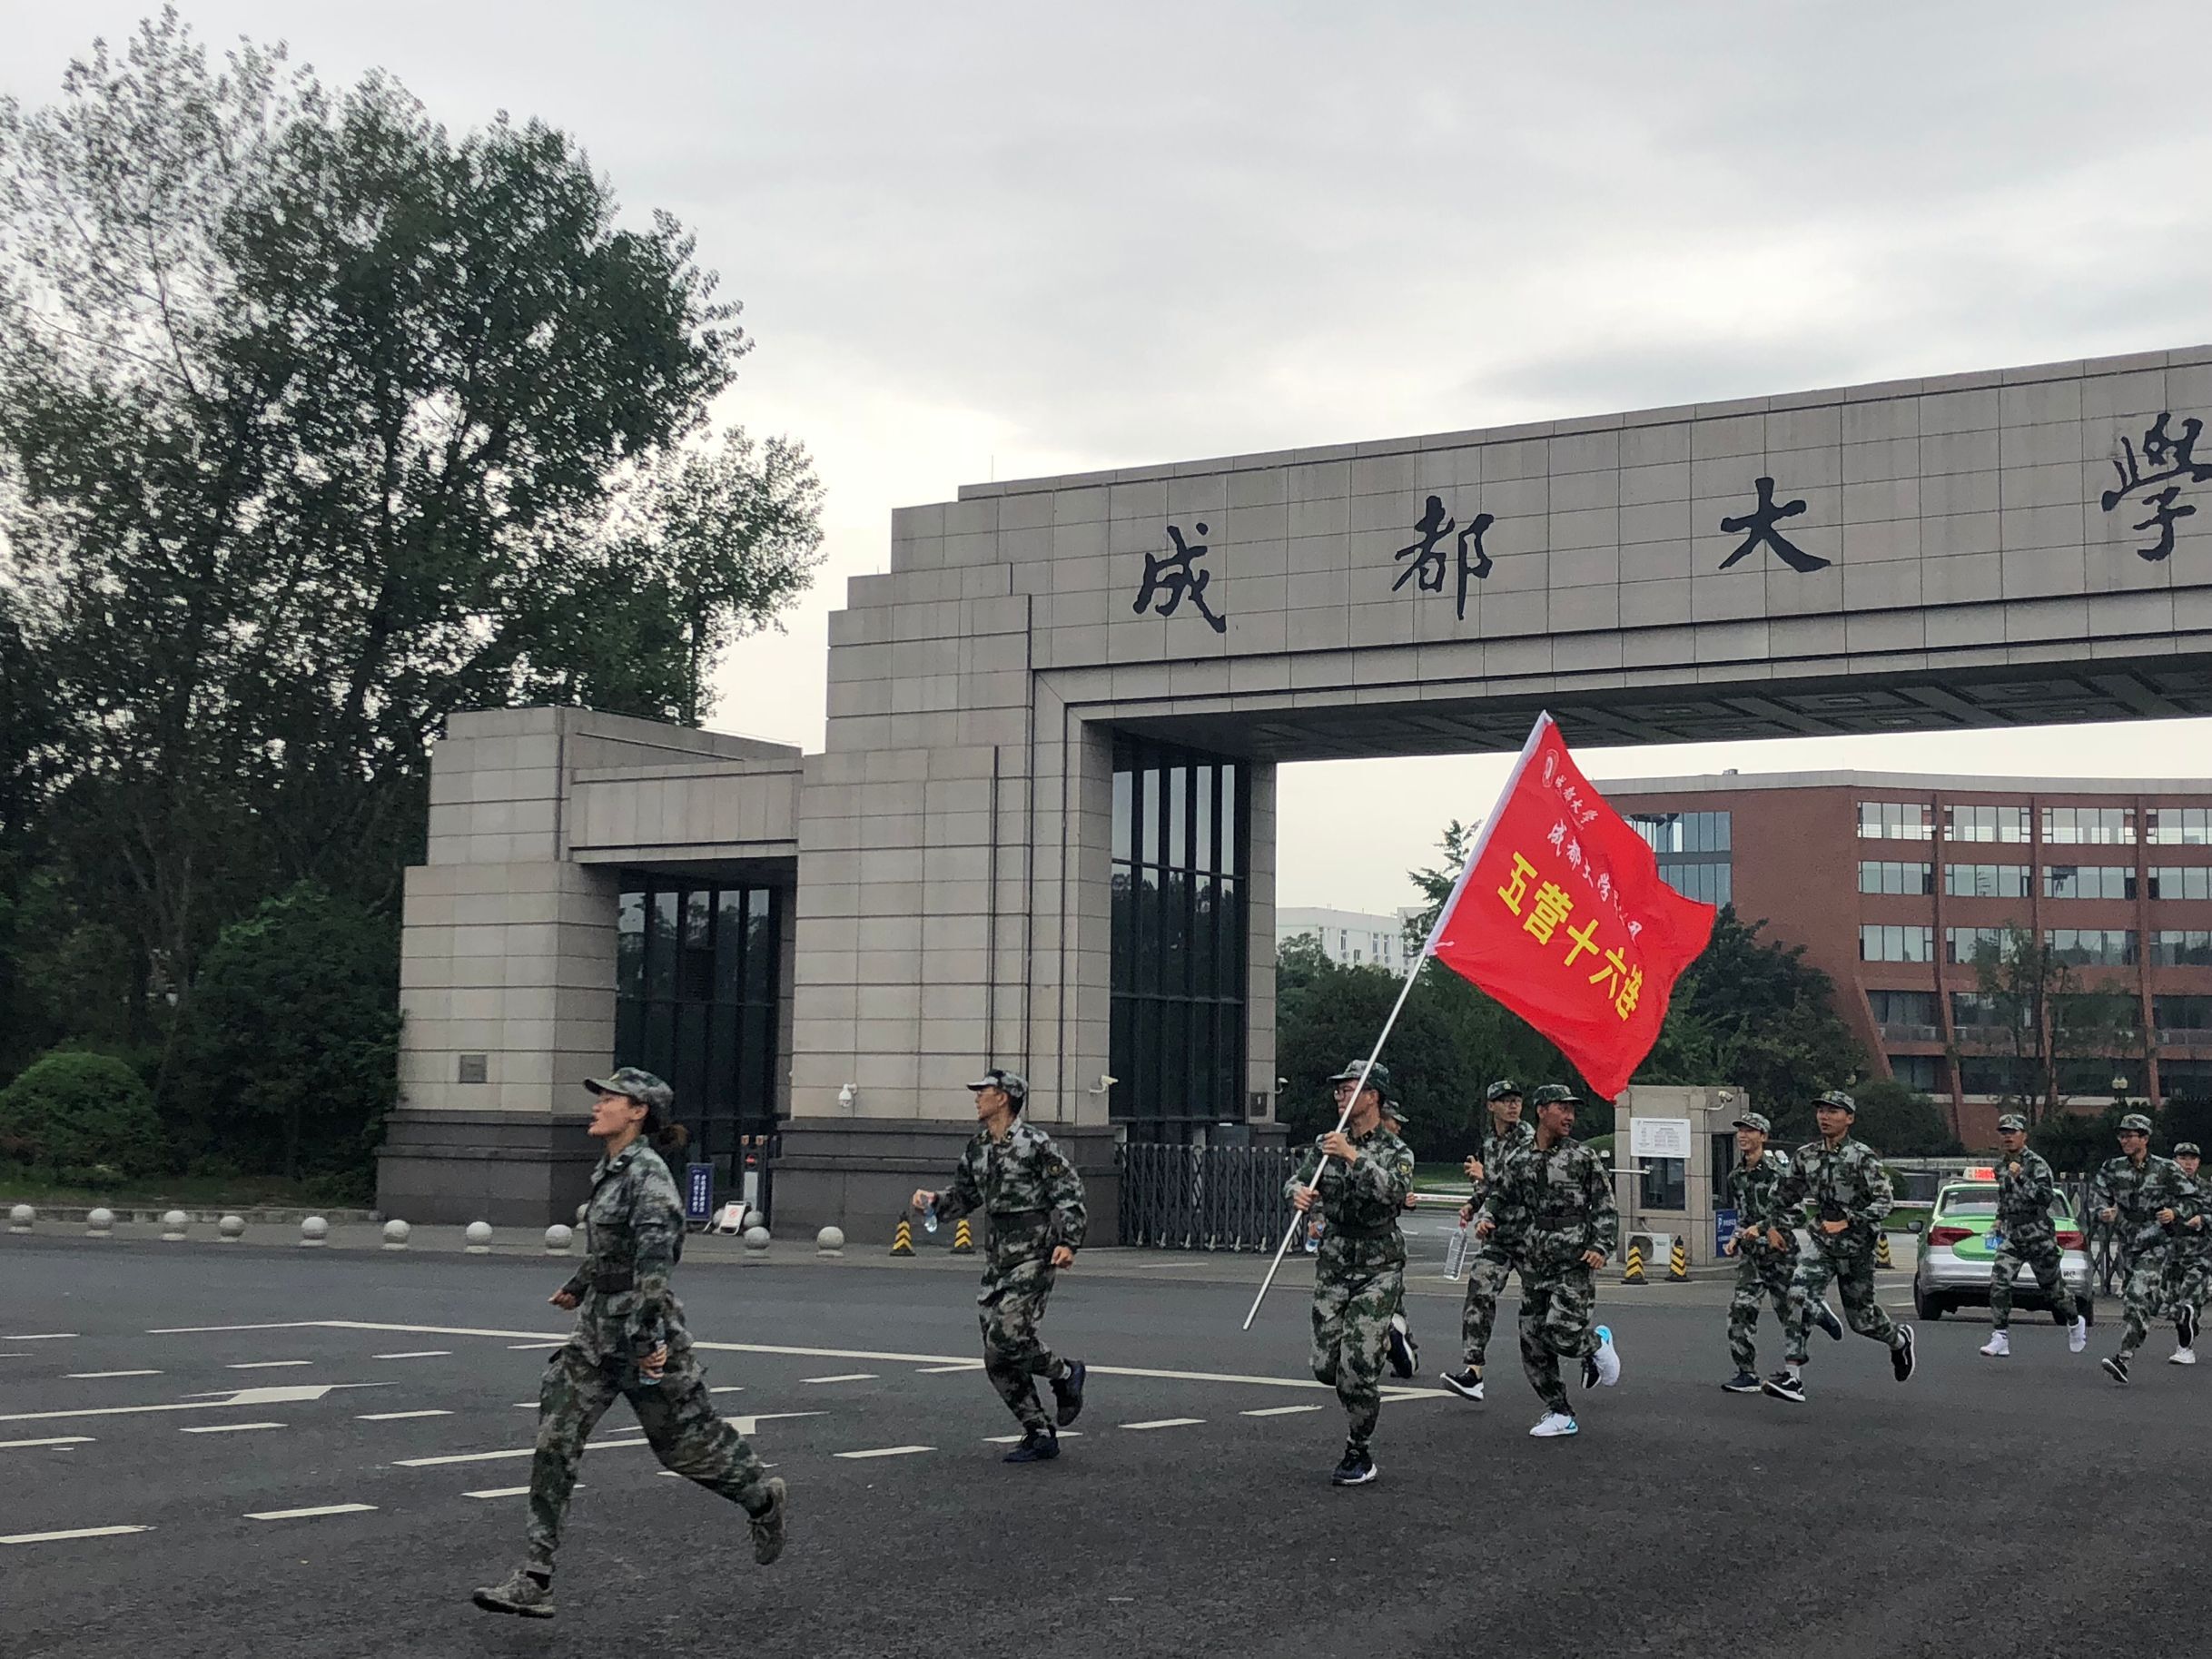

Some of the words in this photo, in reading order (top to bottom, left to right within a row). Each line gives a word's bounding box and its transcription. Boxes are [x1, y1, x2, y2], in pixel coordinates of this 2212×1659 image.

[1498, 852, 1643, 1021] 五营十六连
